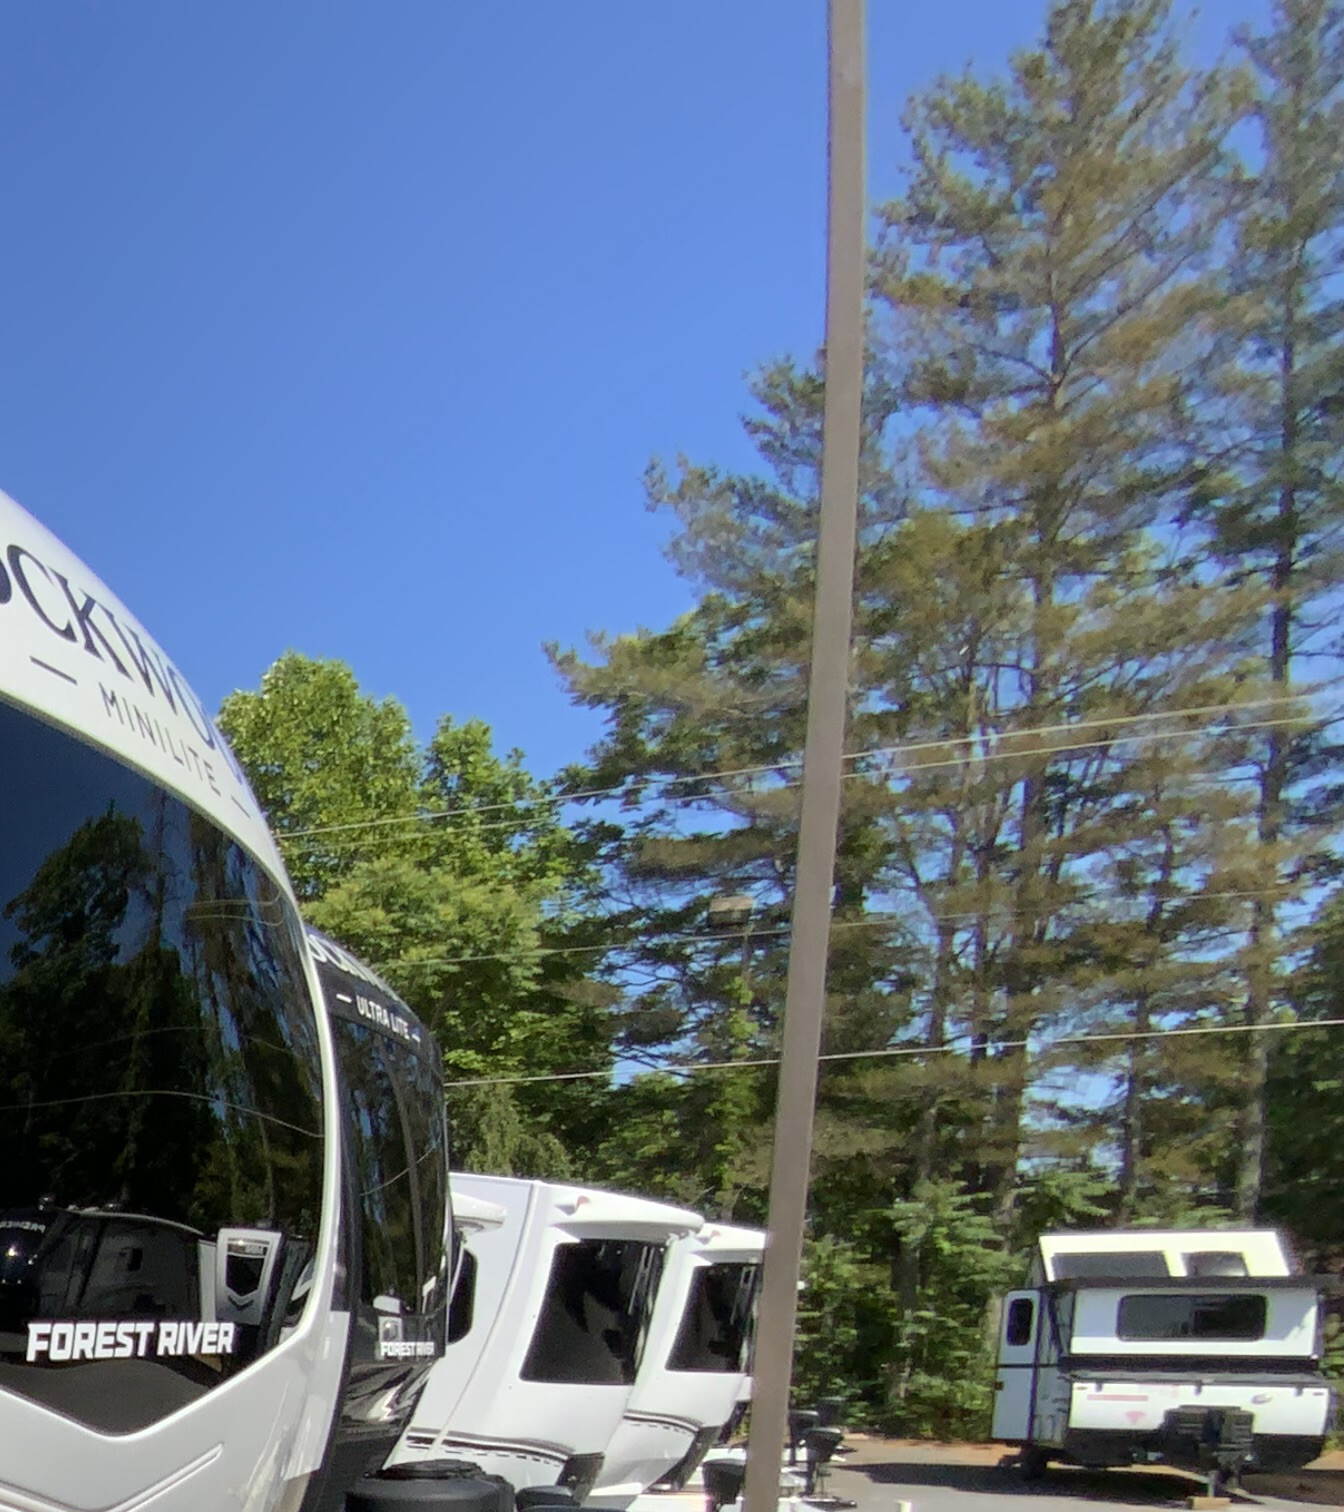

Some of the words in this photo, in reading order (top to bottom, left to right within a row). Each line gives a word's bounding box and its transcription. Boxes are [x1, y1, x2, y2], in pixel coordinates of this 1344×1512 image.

[98, 680, 222, 797] MINILITE
[355, 994, 391, 1028] ULTRA
[390, 1012, 411, 1040] LITE
[25, 1321, 154, 1362] FOREST
[156, 1321, 235, 1356] RIVER
